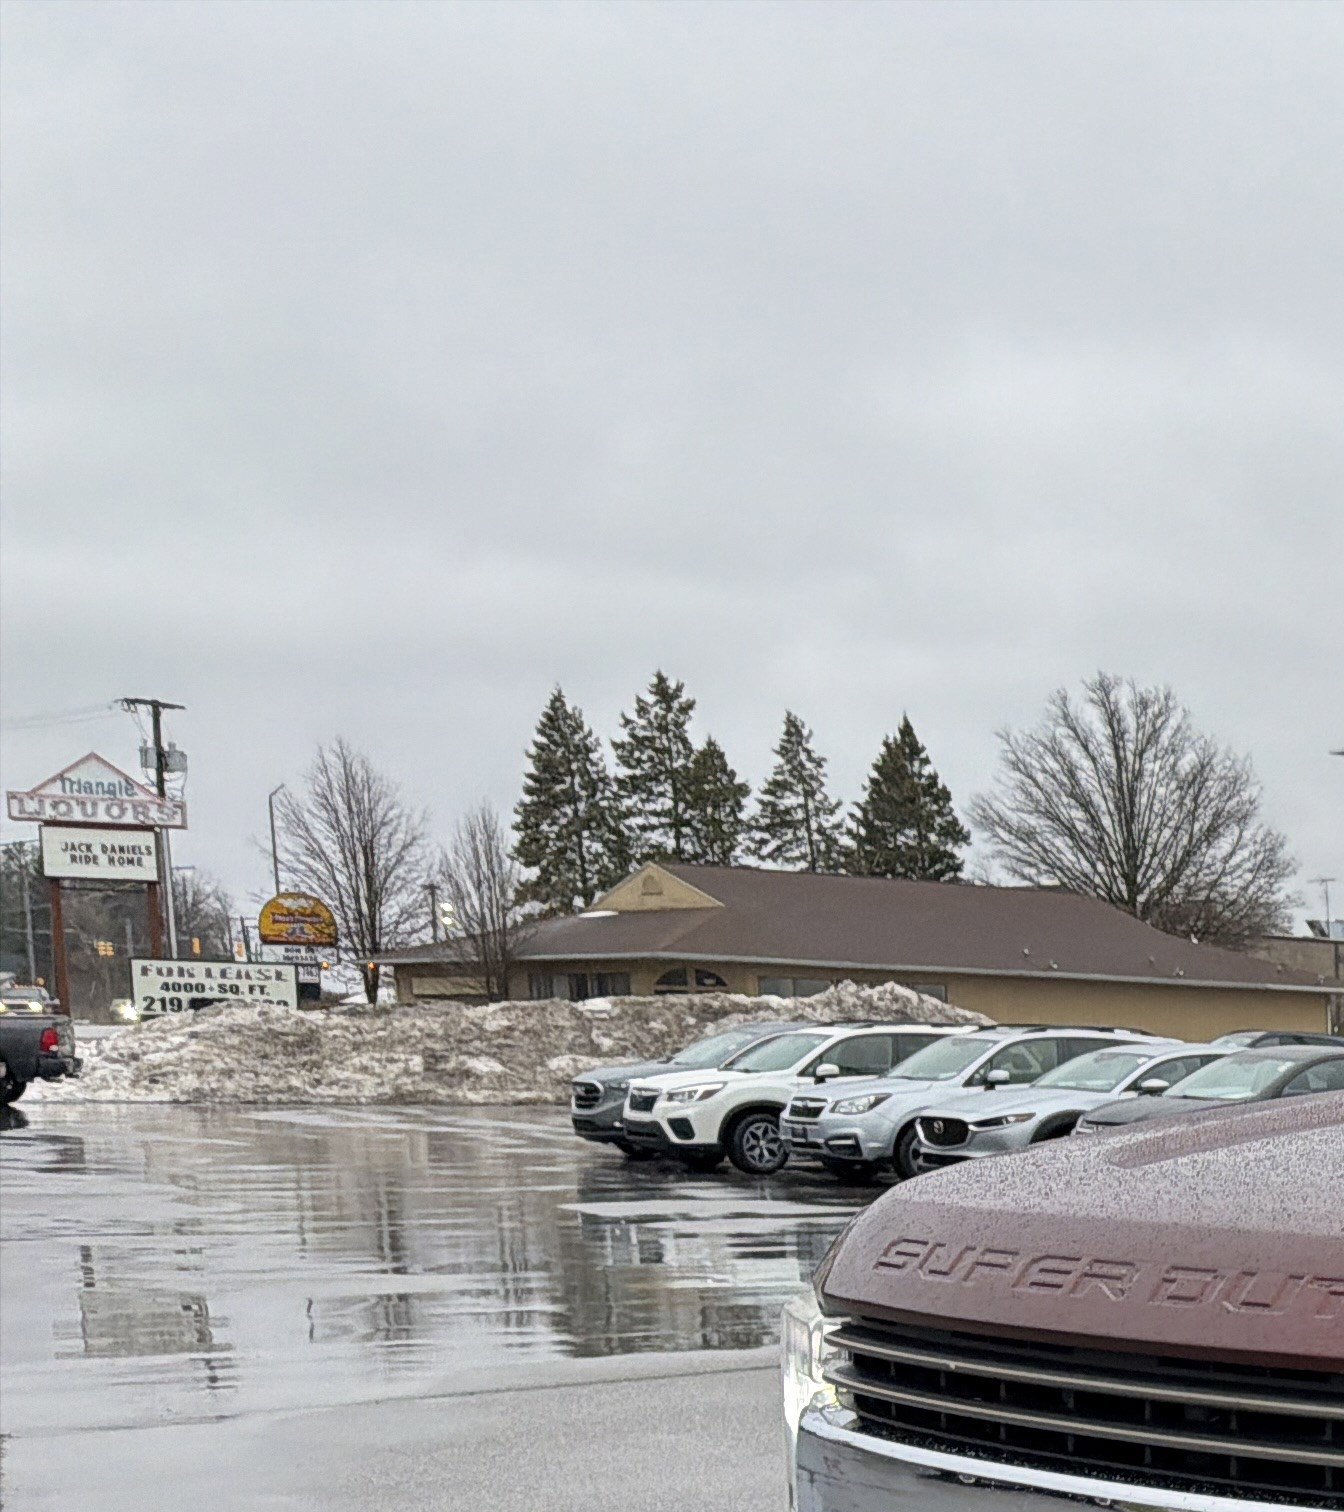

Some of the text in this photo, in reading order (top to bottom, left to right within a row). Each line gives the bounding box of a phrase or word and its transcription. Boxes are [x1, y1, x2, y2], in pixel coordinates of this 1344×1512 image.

[60, 776, 137, 799] Triangle
[18, 797, 179, 825] LIQUORS
[61, 841, 153, 857] JACK DANIELS
[70, 853, 144, 867] RIDE HOME
[141, 964, 196, 979] FOR
[204, 966, 289, 982] LEASE
[873, 1238, 1142, 1301] SUPER
